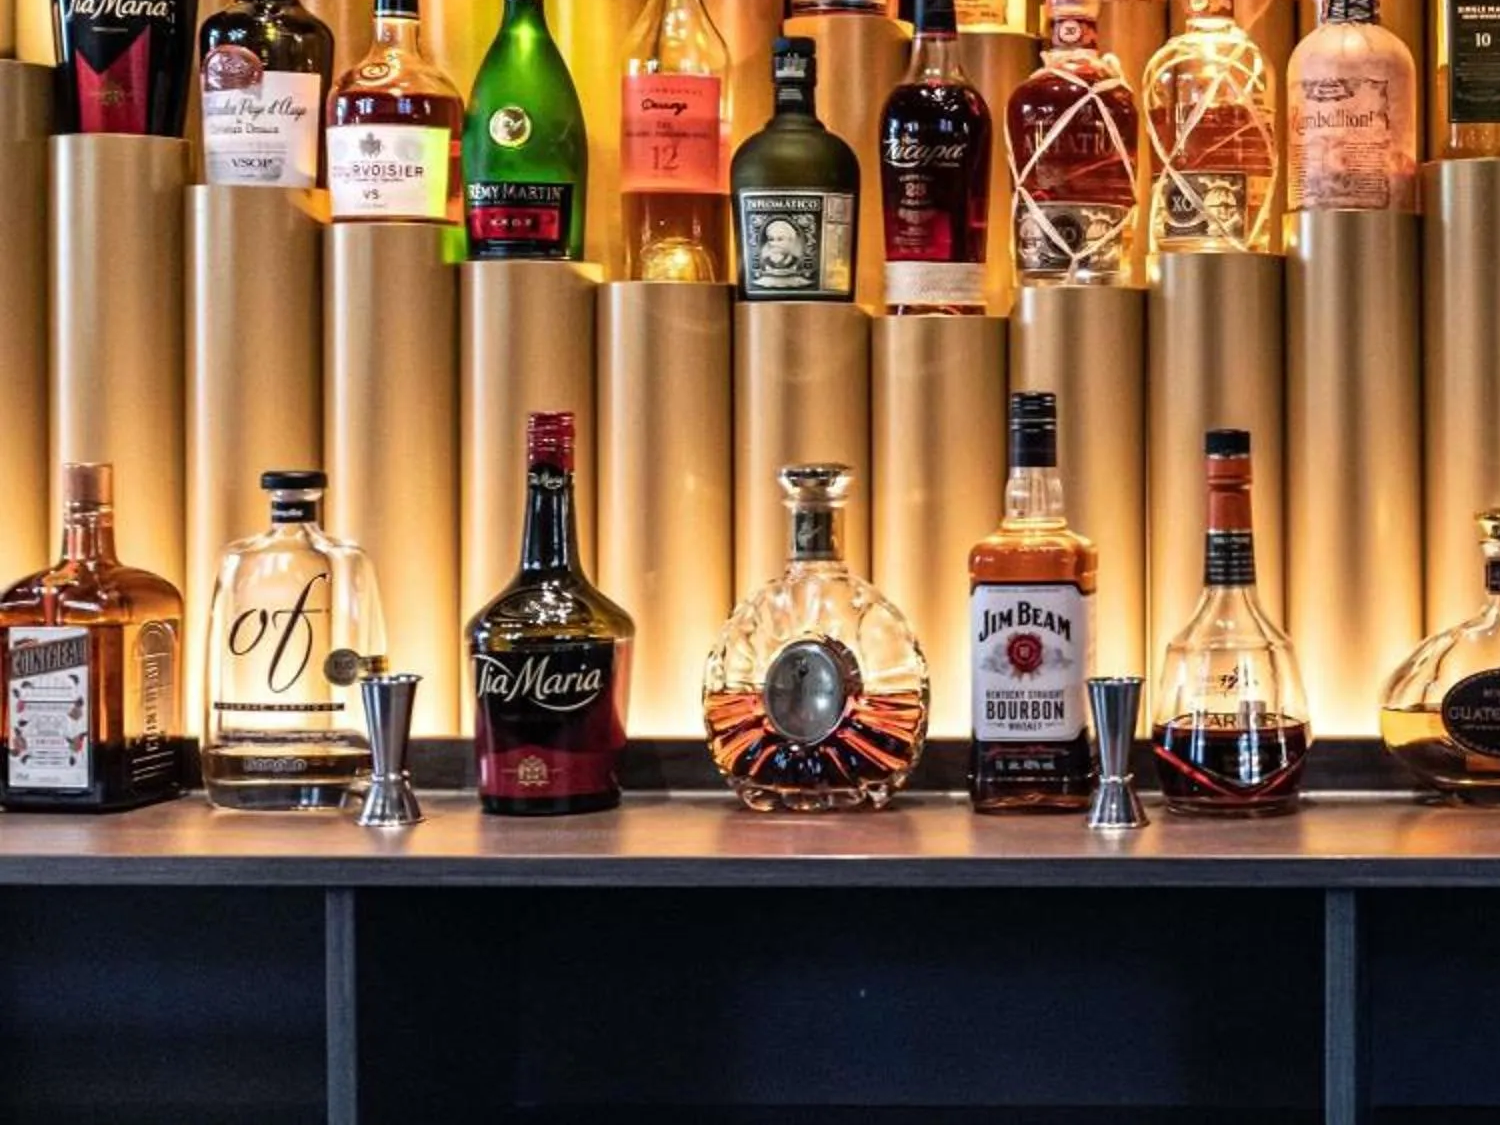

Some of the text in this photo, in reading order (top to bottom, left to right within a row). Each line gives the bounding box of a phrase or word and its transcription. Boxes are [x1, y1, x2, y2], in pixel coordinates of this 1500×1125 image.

[1474, 32, 1492, 48] 10
[651, 145, 680, 172] 12
[883, 137, 968, 167] Zacapa
[231, 157, 273, 169] VSOP
[333, 163, 425, 179] RVOISIER
[362, 188, 381, 201] VS
[502, 185, 564, 200] MARTIN
[1172, 196, 1194, 212] XO
[978, 600, 1072, 642] JIM BEAM
[471, 654, 604, 702] Tia Maria
[986, 700, 1065, 721] BOURBON
